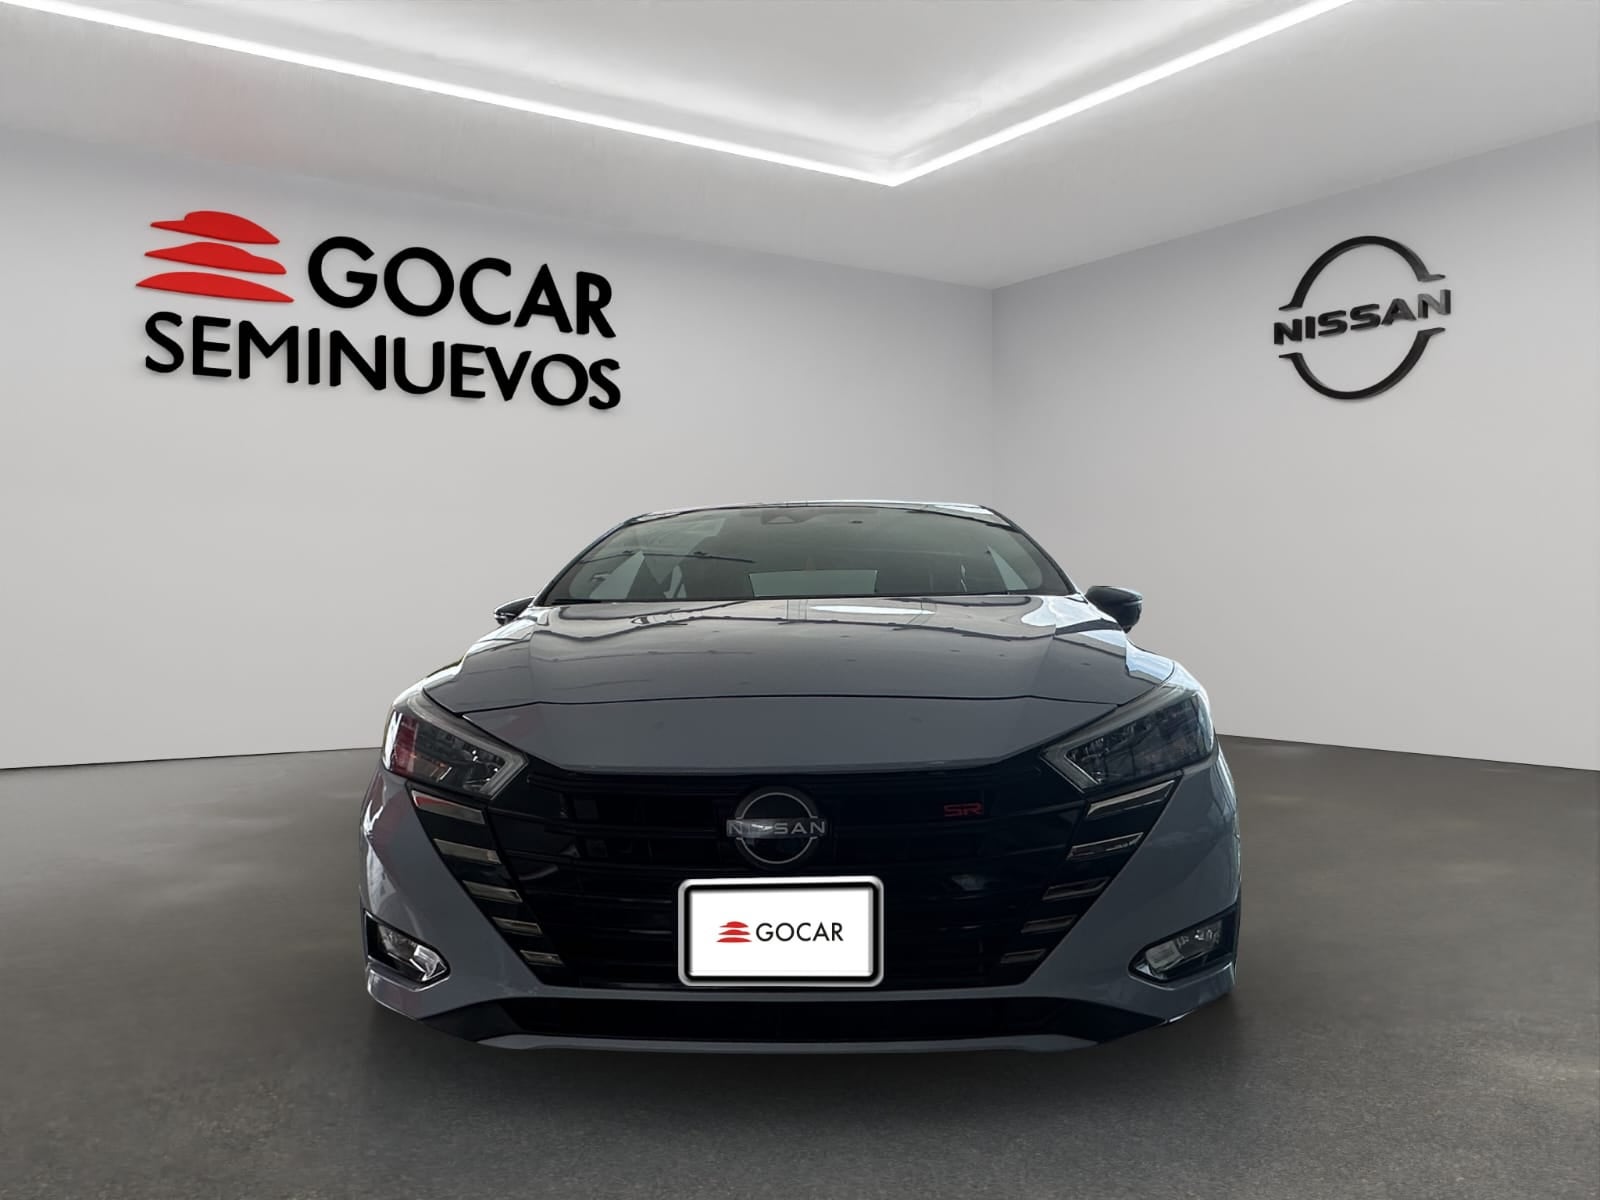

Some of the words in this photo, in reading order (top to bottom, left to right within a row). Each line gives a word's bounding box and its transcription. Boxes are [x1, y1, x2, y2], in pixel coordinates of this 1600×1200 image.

[308, 236, 616, 338] GOCAR
[1274, 289, 1451, 345] NISSAN
[145, 311, 621, 410] SEMINUEVOS
[944, 803, 982, 816] SR
[756, 922, 844, 942] GOCAR
